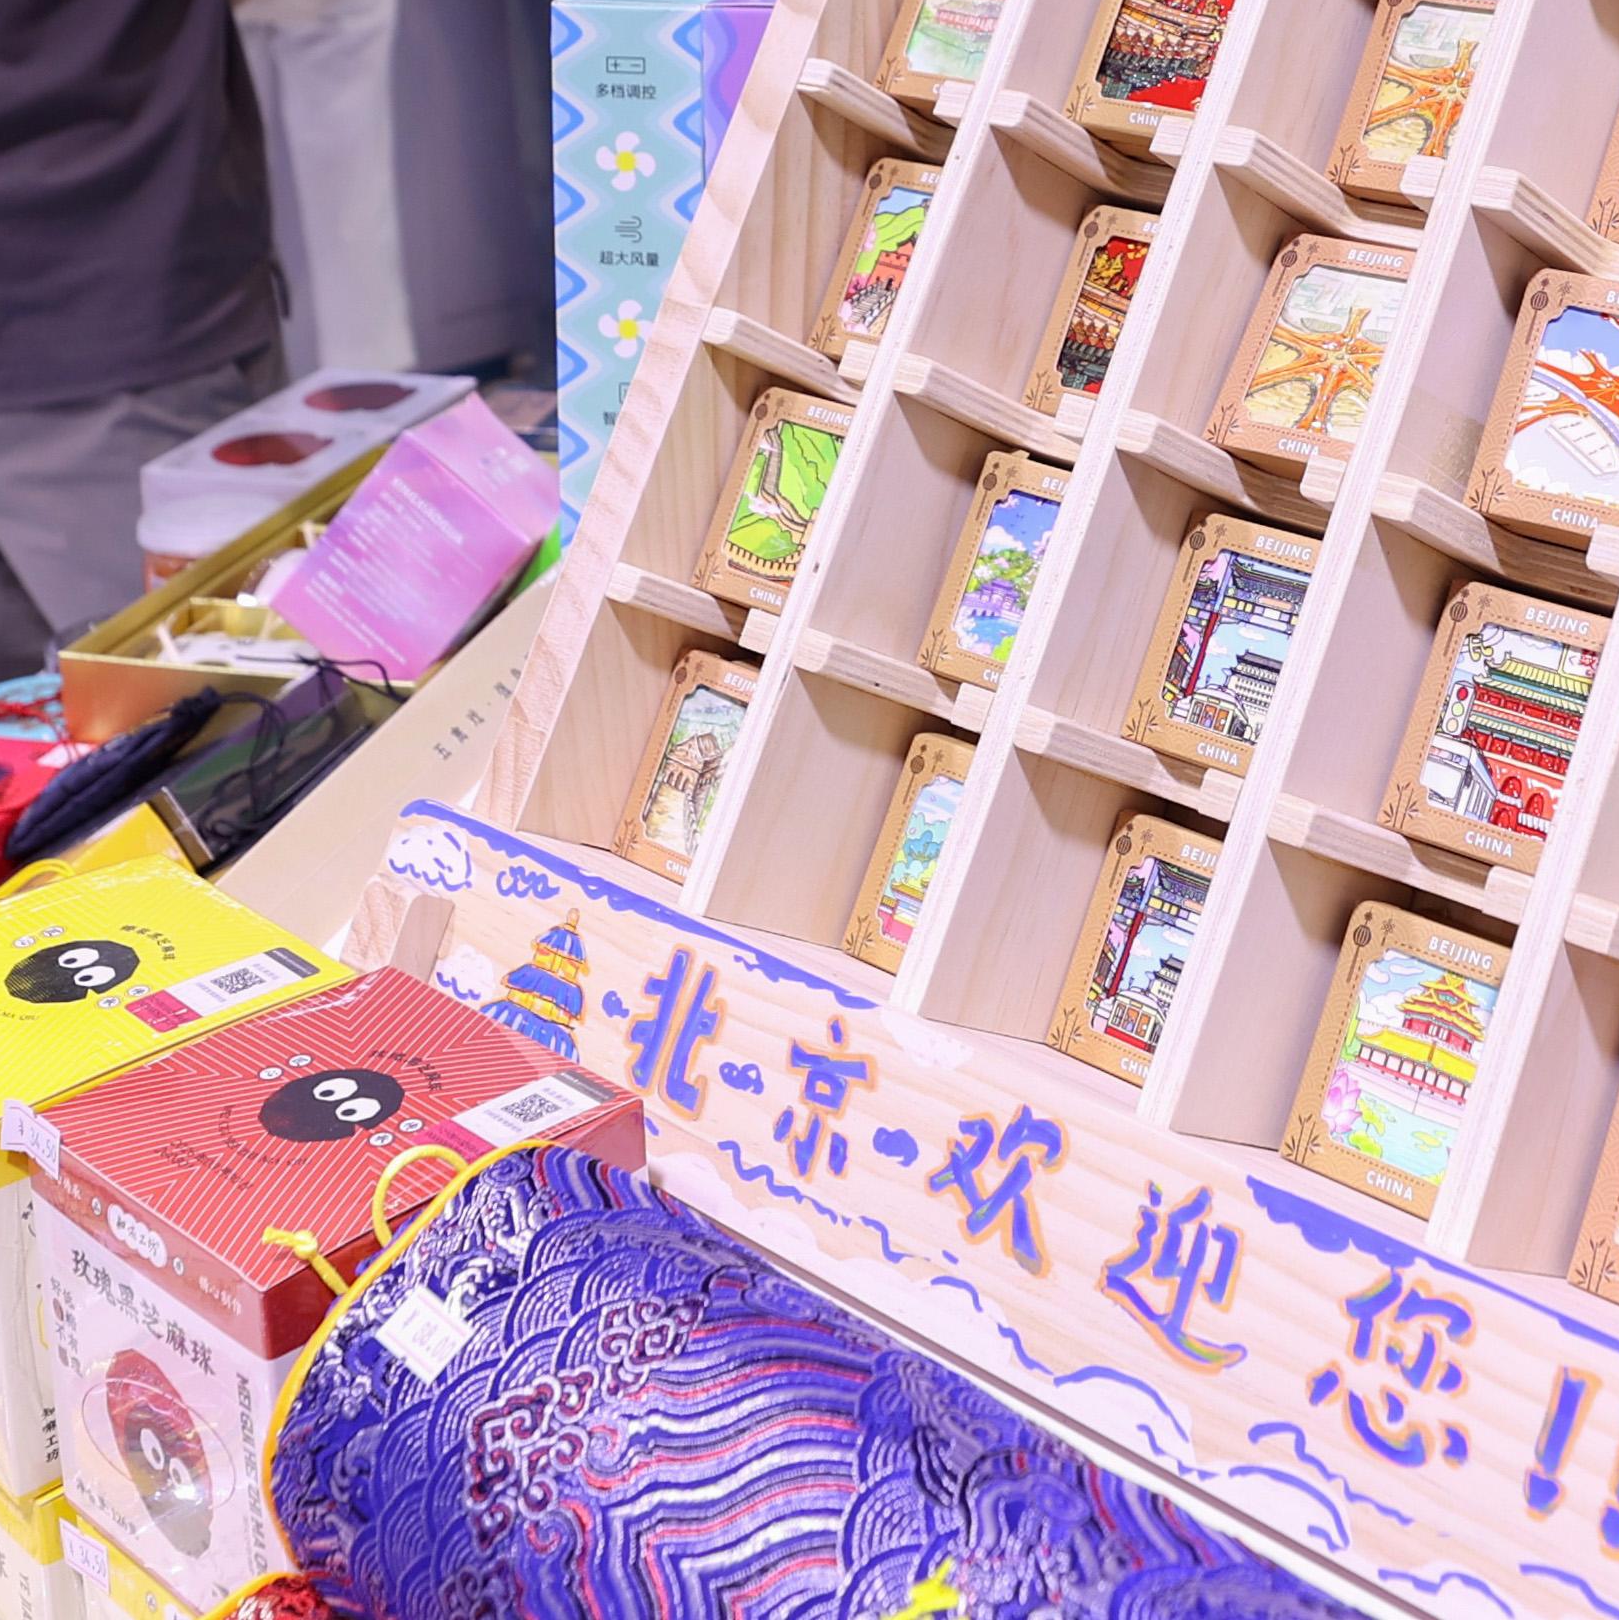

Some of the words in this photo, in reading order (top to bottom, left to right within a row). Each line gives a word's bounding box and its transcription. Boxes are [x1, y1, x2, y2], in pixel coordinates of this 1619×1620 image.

[595, 82, 657, 100] 多档调控
[1128, 111, 1160, 126] CHIN
[598, 250, 660, 268] 超大风量
[1347, 248, 1404, 269] BEIJING
[1277, 437, 1321, 457] CHINA
[1551, 507, 1600, 530] CHINA
[1255, 534, 1312, 562] BEIJING
[1524, 606, 1592, 635] BEIJING
[1195, 741, 1241, 766] CHINA
[1180, 843, 1219, 868] BEIJI
[1464, 829, 1514, 858] CHINA
[1428, 935, 1494, 971] BEIJING
[1120, 1055, 1153, 1080] CHIN
[1365, 1169, 1415, 1202] CHINA
[70, 1248, 216, 1377] 玫瑰黑芝麻球
